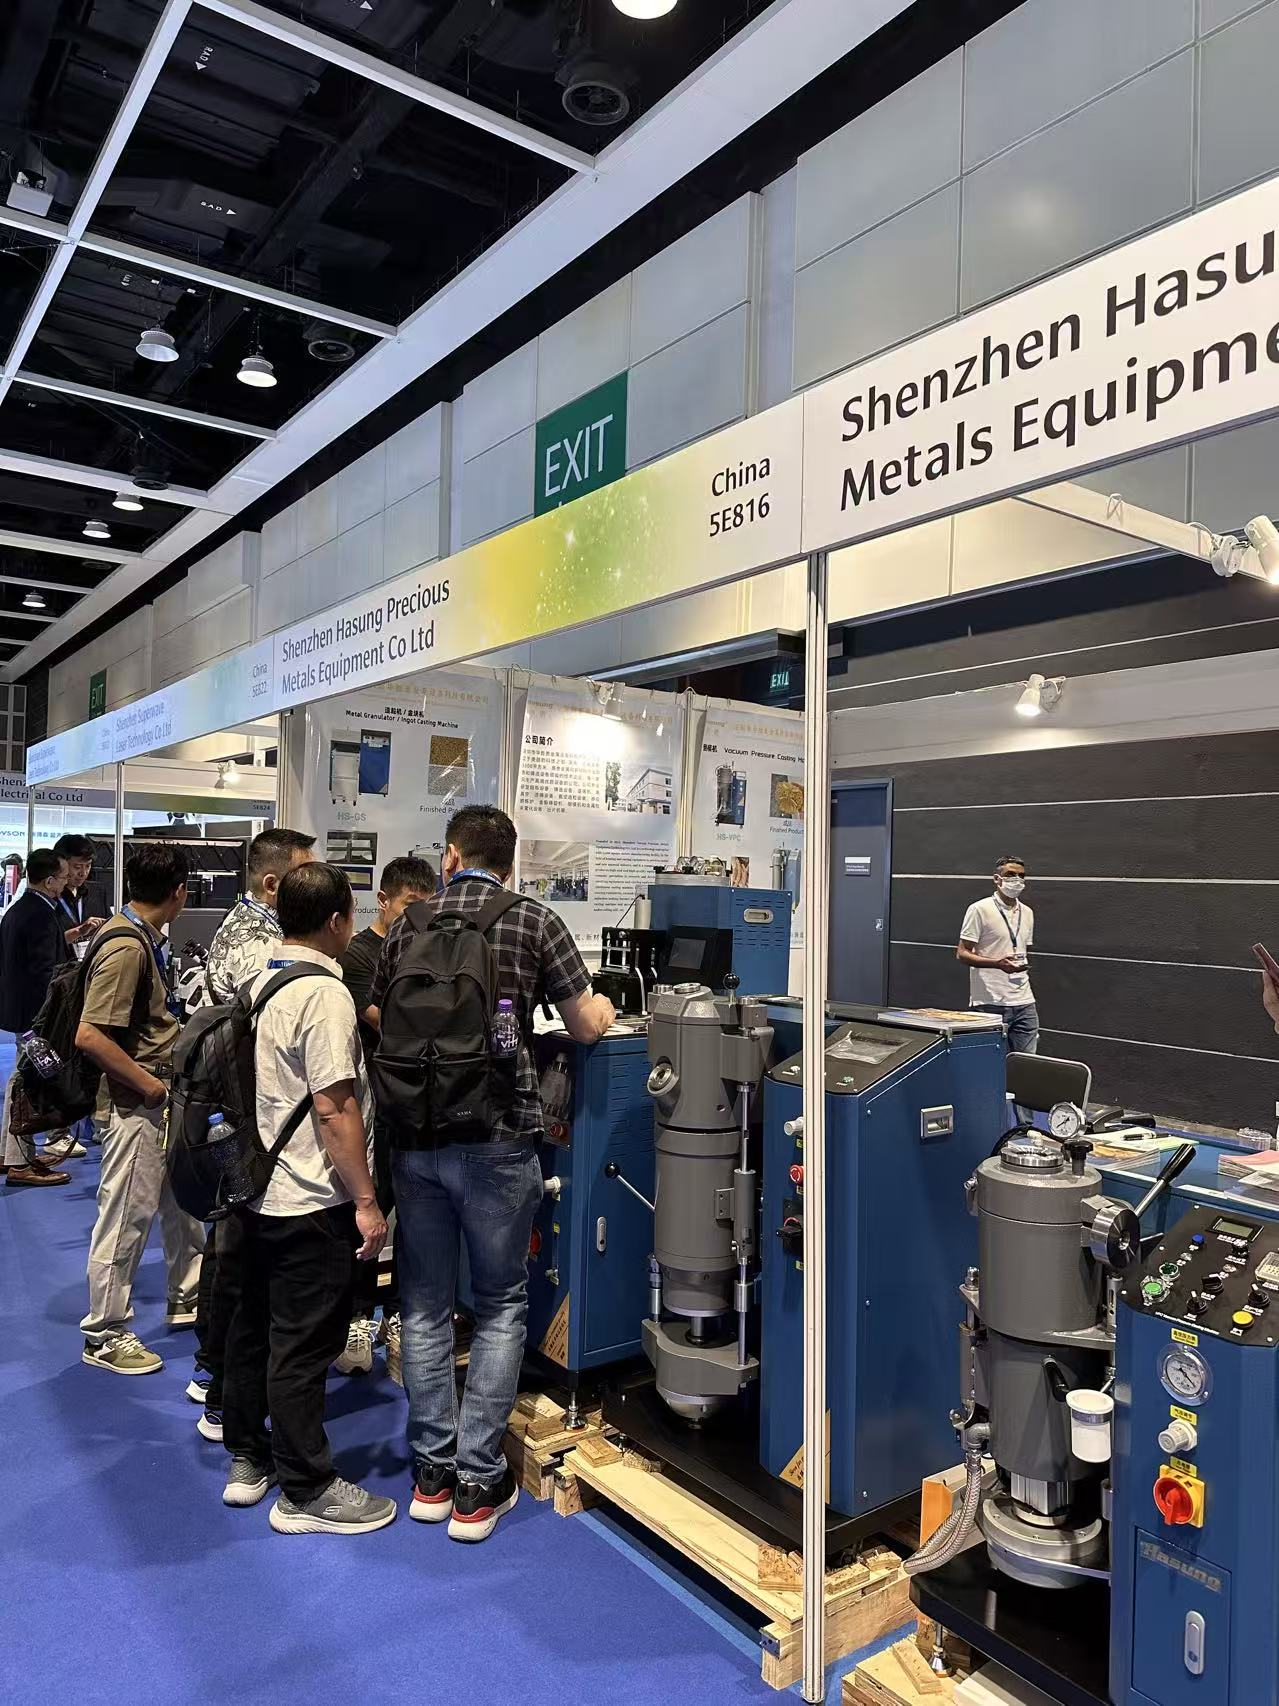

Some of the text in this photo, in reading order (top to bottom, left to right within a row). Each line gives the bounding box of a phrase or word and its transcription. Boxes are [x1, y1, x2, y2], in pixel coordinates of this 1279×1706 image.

[841, 229, 1275, 442] Shenzhen Hasu
[544, 413, 614, 498] EXIT
[840, 421, 993, 512] Metals
[711, 457, 771, 497] China
[708, 492, 771, 537] 5E816
[282, 579, 450, 663] Shenzhen Hasung Precious
[281, 619, 435, 695] Metals Equipment Co Ltd
[127, 729, 154, 751] Technology
[162, 719, 172, 738] Ltd
[345, 709, 363, 718] Metal
[364, 711, 396, 722] Granulator
[401, 716, 416, 725] Ingot
[416, 718, 437, 728] Casting
[437, 720, 459, 729] Machine
[525, 734, 554, 746] 公司简介
[723, 747, 749, 756] Vacuum
[751, 750, 775, 759] Pressure
[777, 753, 796, 763] Casting
[1, 789, 83, 802] lectrial Co Ltd
[420, 805, 447, 814] Finished
